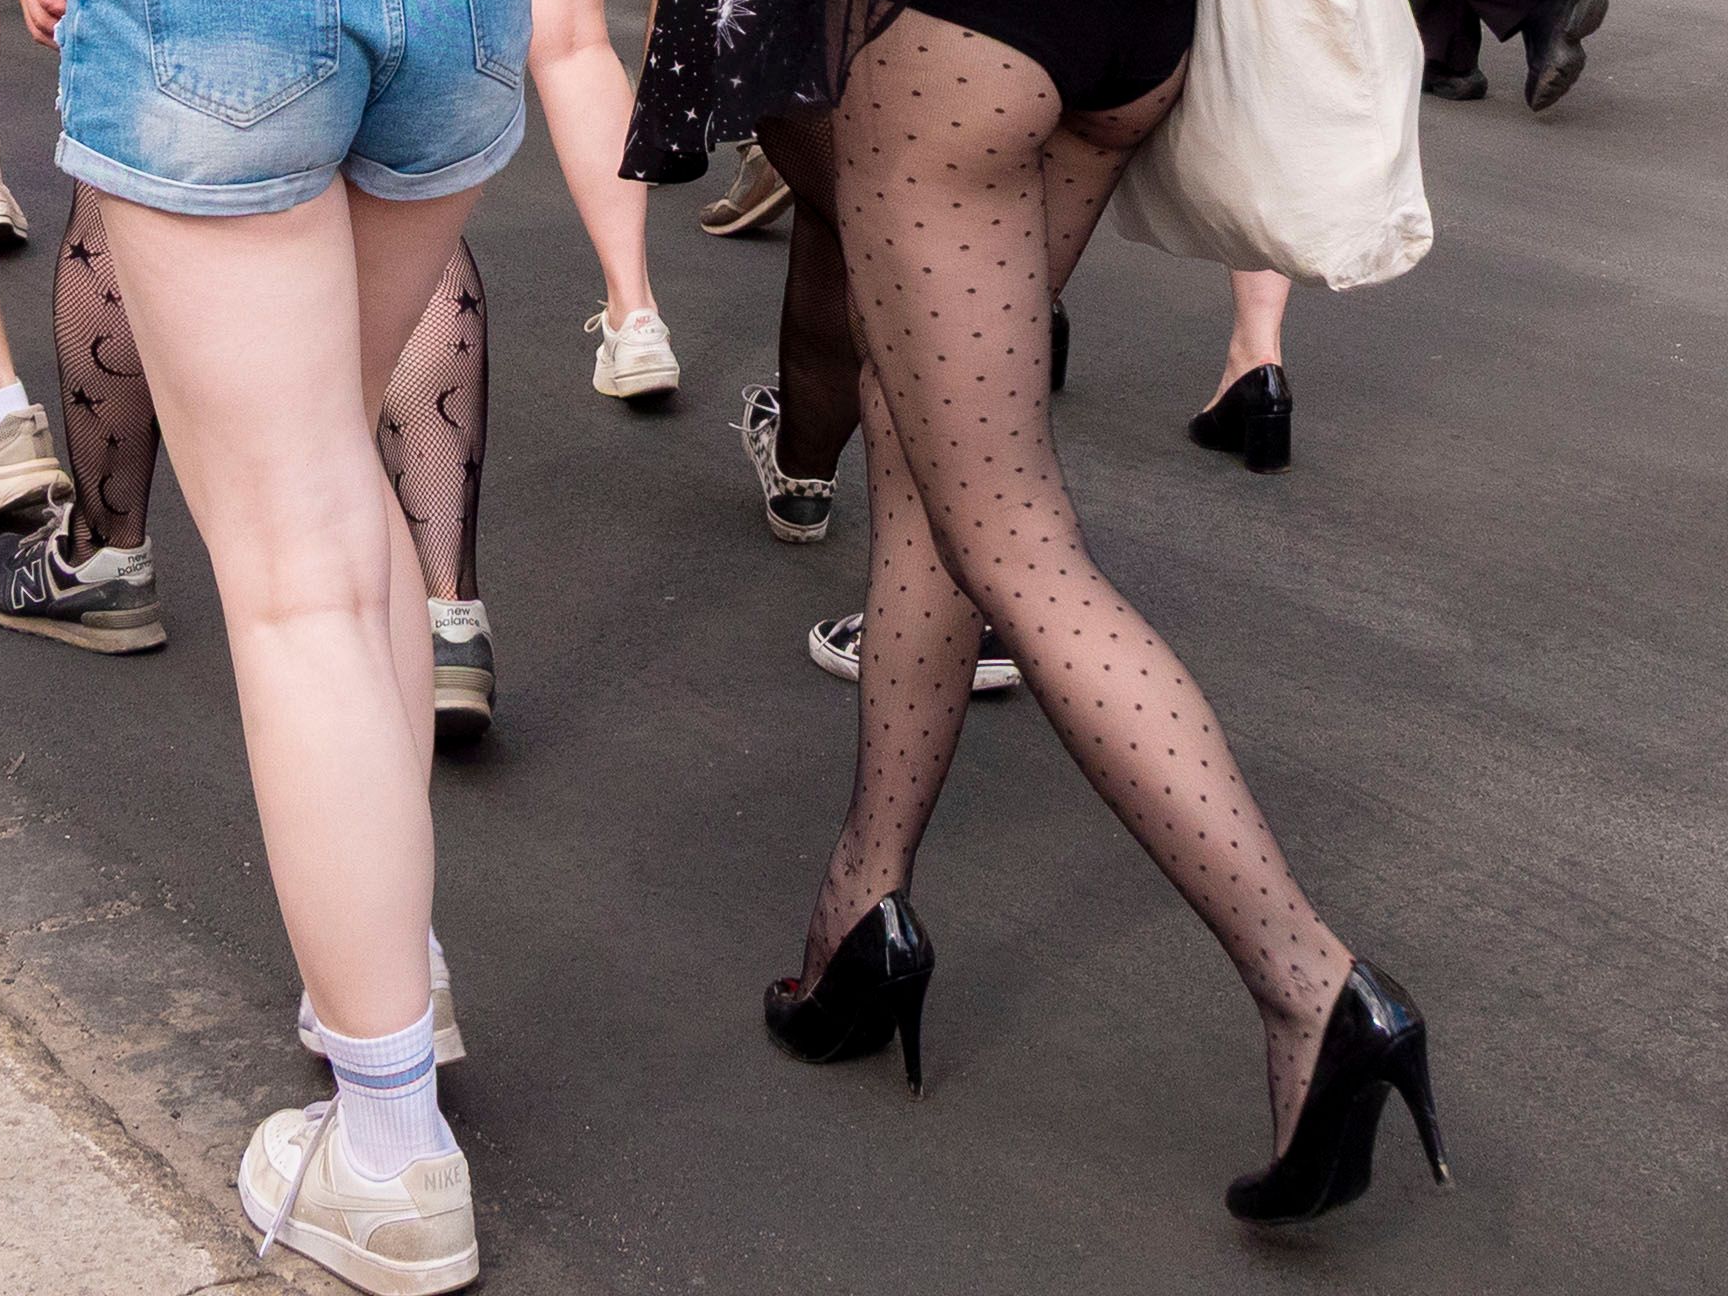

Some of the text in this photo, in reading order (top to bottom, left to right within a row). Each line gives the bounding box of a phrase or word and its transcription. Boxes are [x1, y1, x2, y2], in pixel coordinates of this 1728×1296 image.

[447, 607, 471, 616] new
[435, 616, 480, 628] balance
[423, 1164, 462, 1191] NIKE
